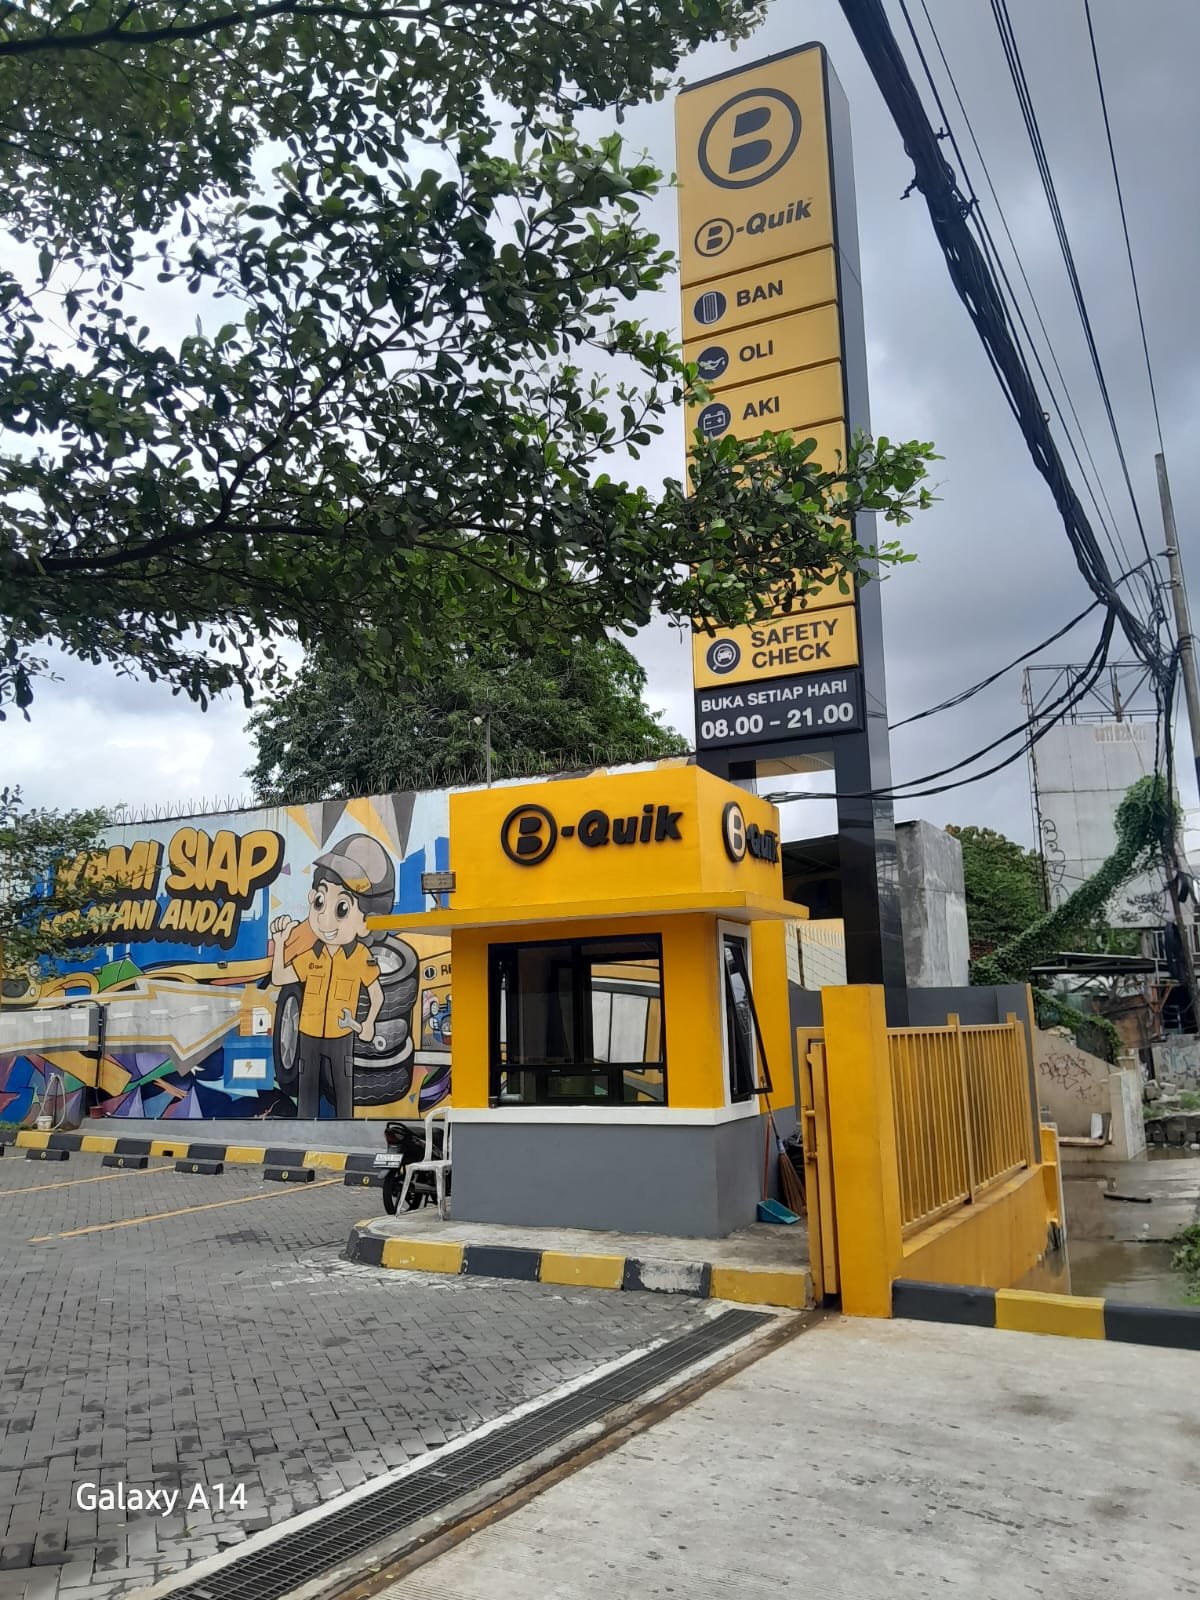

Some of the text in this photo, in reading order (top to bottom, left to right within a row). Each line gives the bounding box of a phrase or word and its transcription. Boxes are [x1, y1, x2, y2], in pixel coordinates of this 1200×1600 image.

[695, 198, 812, 257] B-Quik
[736, 280, 784, 307] BAN
[738, 340, 774, 363] OLI
[742, 396, 780, 420] AKI
[751, 618, 838, 648] SAFETY
[752, 641, 831, 669] CHECK
[701, 679, 847, 713] BUKA SETIAP HARI
[701, 714, 763, 740] 08.00
[787, 702, 853, 729] 21.00
[501, 804, 683, 866] B-Quik
[165, 826, 280, 898] SIAP
[159, 899, 236, 938] ANDA
